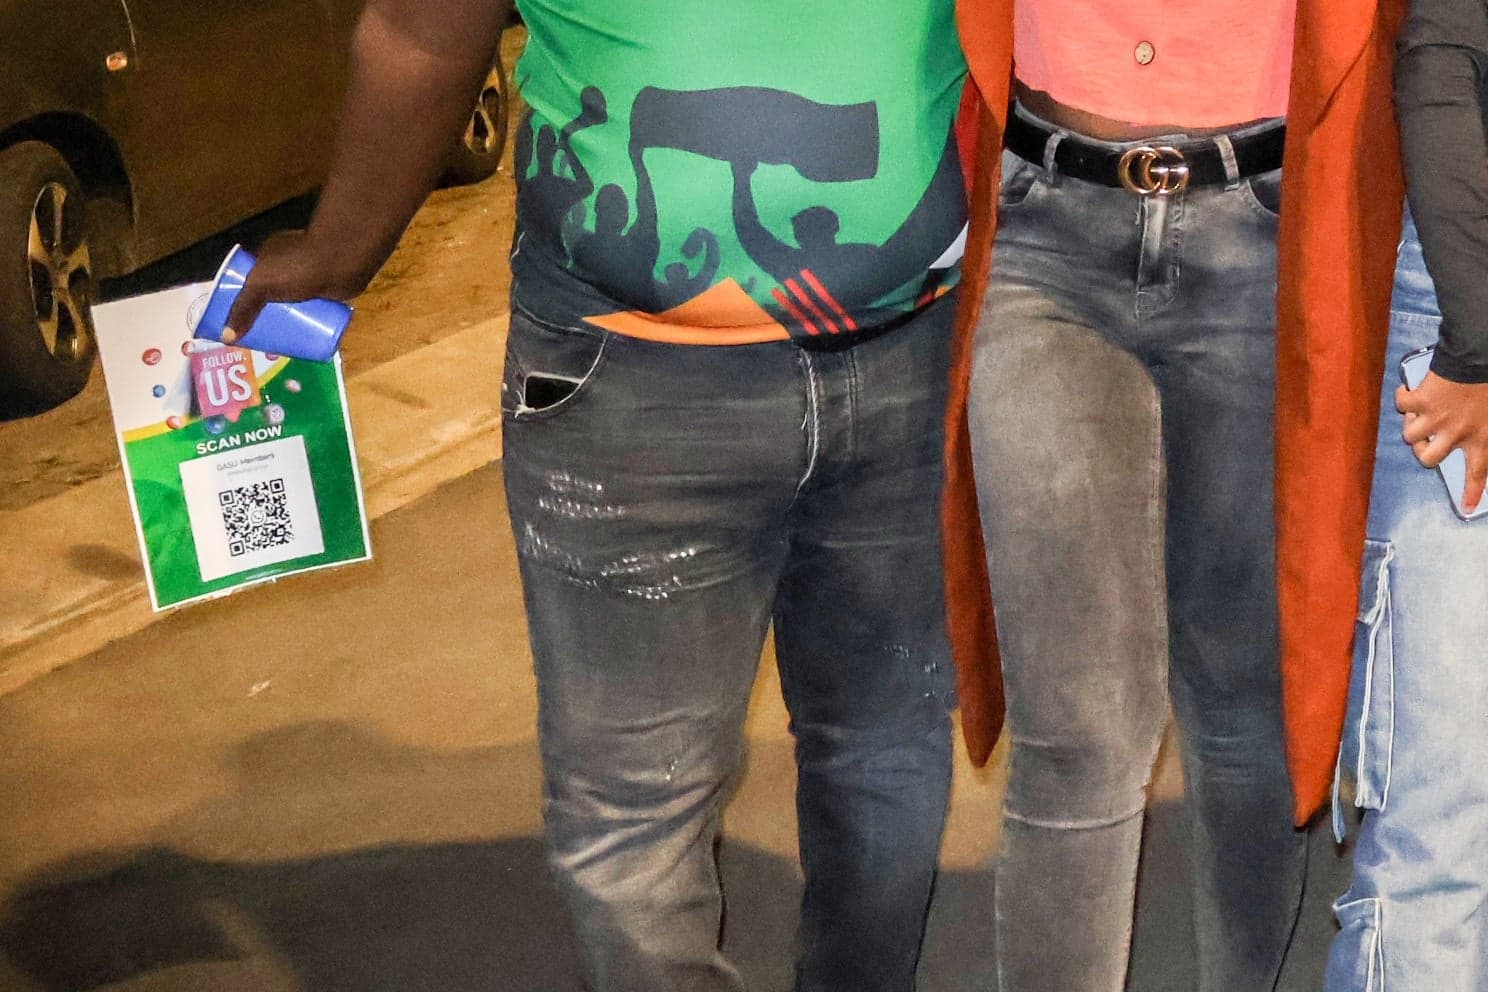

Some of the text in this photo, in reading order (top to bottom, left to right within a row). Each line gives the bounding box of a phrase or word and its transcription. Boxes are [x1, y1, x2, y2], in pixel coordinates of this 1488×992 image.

[203, 364, 252, 407] US
[196, 425, 282, 455] SCAN NOW
